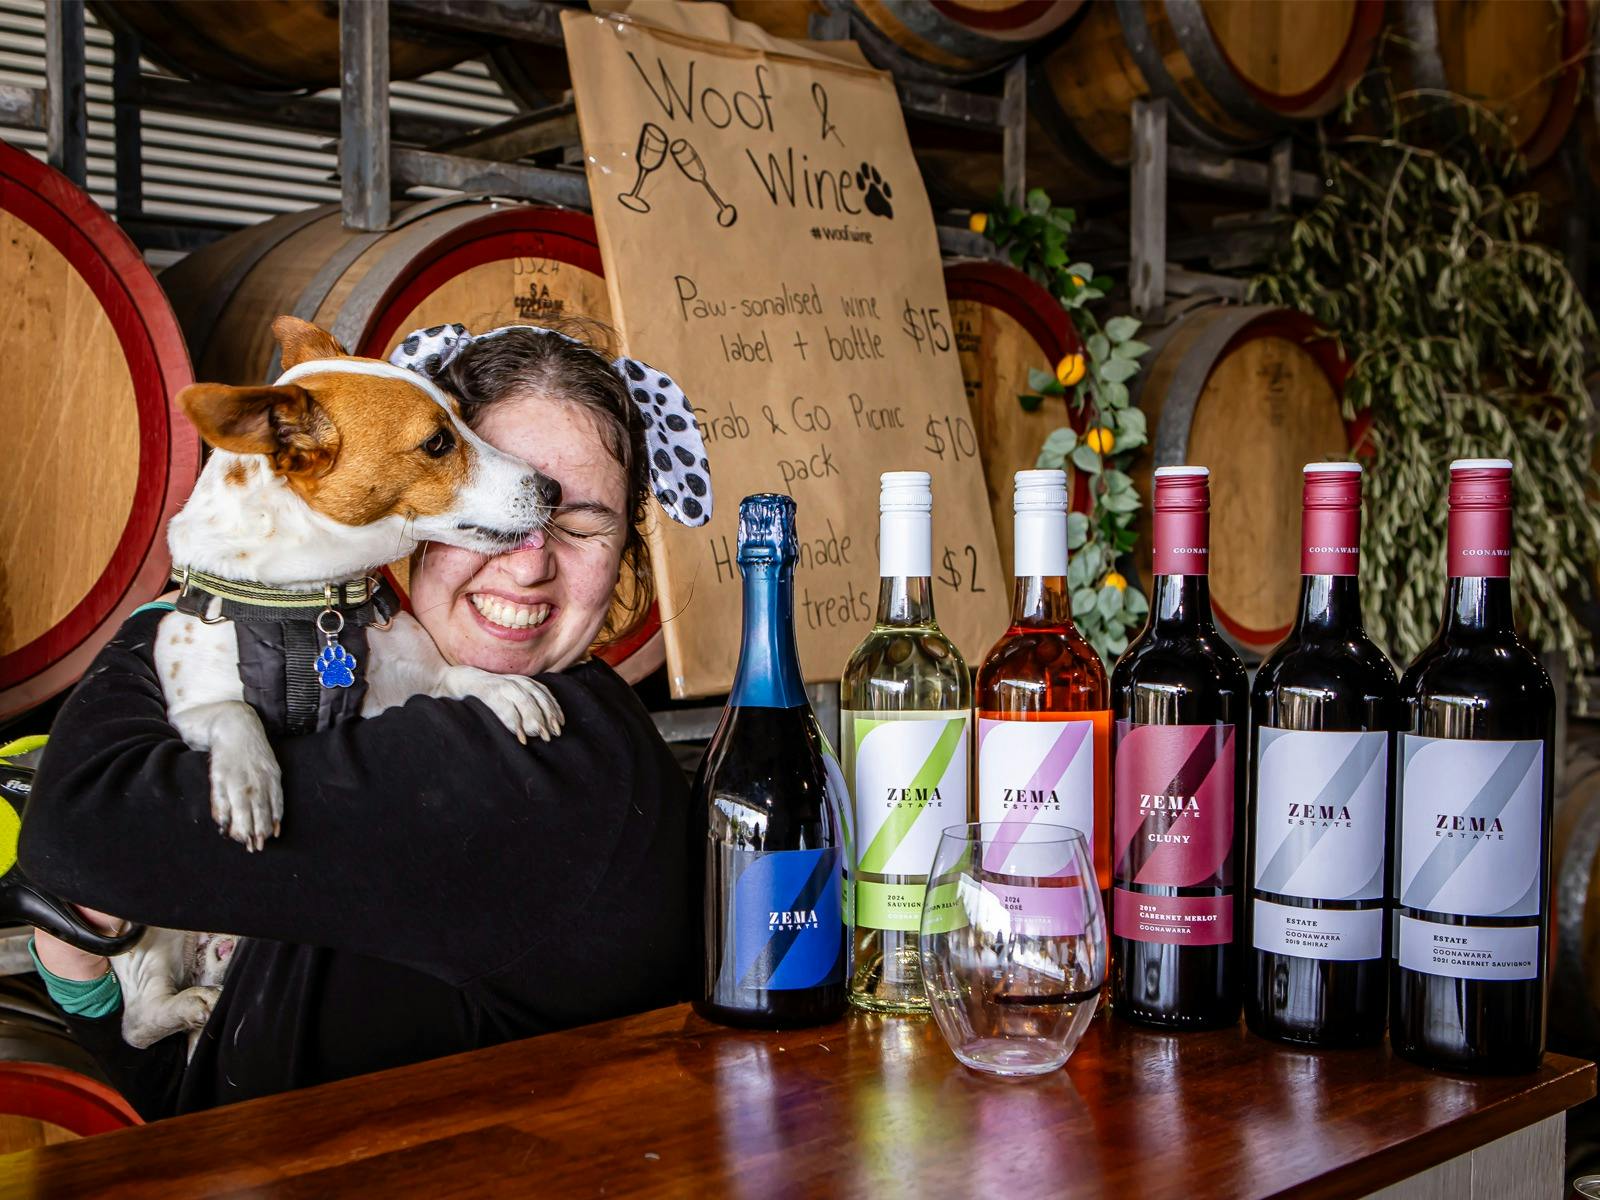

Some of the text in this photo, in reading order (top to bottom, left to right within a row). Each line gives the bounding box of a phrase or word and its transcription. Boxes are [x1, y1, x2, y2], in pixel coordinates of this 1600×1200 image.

[626, 50, 845, 147] Woof &
[745, 147, 861, 215] Wine
[674, 275, 950, 357] Paw-sonalised wine $15
[720, 329, 774, 363] label
[824, 325, 885, 362] bottle
[692, 401, 750, 445] Grab
[761, 404, 787, 435] &
[925, 414, 977, 462] $10
[777, 443, 840, 494] pack
[938, 545, 986, 593] $2
[801, 581, 872, 630] treats
[887, 787, 942, 801] ZEMA
[1003, 788, 1060, 803] ZEMA
[1003, 803, 1061, 811] ESTATE
[1140, 794, 1200, 810] ZEMA
[1139, 809, 1201, 818] ESTATE
[1288, 803, 1352, 820] ZEMA
[1288, 818, 1352, 828] ESTATE
[1436, 814, 1504, 832] ZEMA
[1148, 833, 1191, 844] CLUNY
[1435, 830, 1505, 840] ESTATE
[1004, 895, 1020, 904] 2024
[1139, 904, 1157, 912] 2019
[768, 910, 818, 925] ZEMA
[1139, 912, 1218, 922] CABERNET MERLOT
[1286, 917, 1318, 927] ESTATE
[768, 922, 819, 931] ESTATE
[1139, 924, 1192, 934] COONAWARRA
[1285, 930, 1341, 941] COONAWARRA
[1433, 934, 1468, 945] ESTATE
[1302, 940, 1329, 948] SHIRAZ
[1432, 948, 1492, 959] COONAWARRA
[1432, 956, 1449, 965] 2021
[1451, 959, 1490, 968] CABERNET
